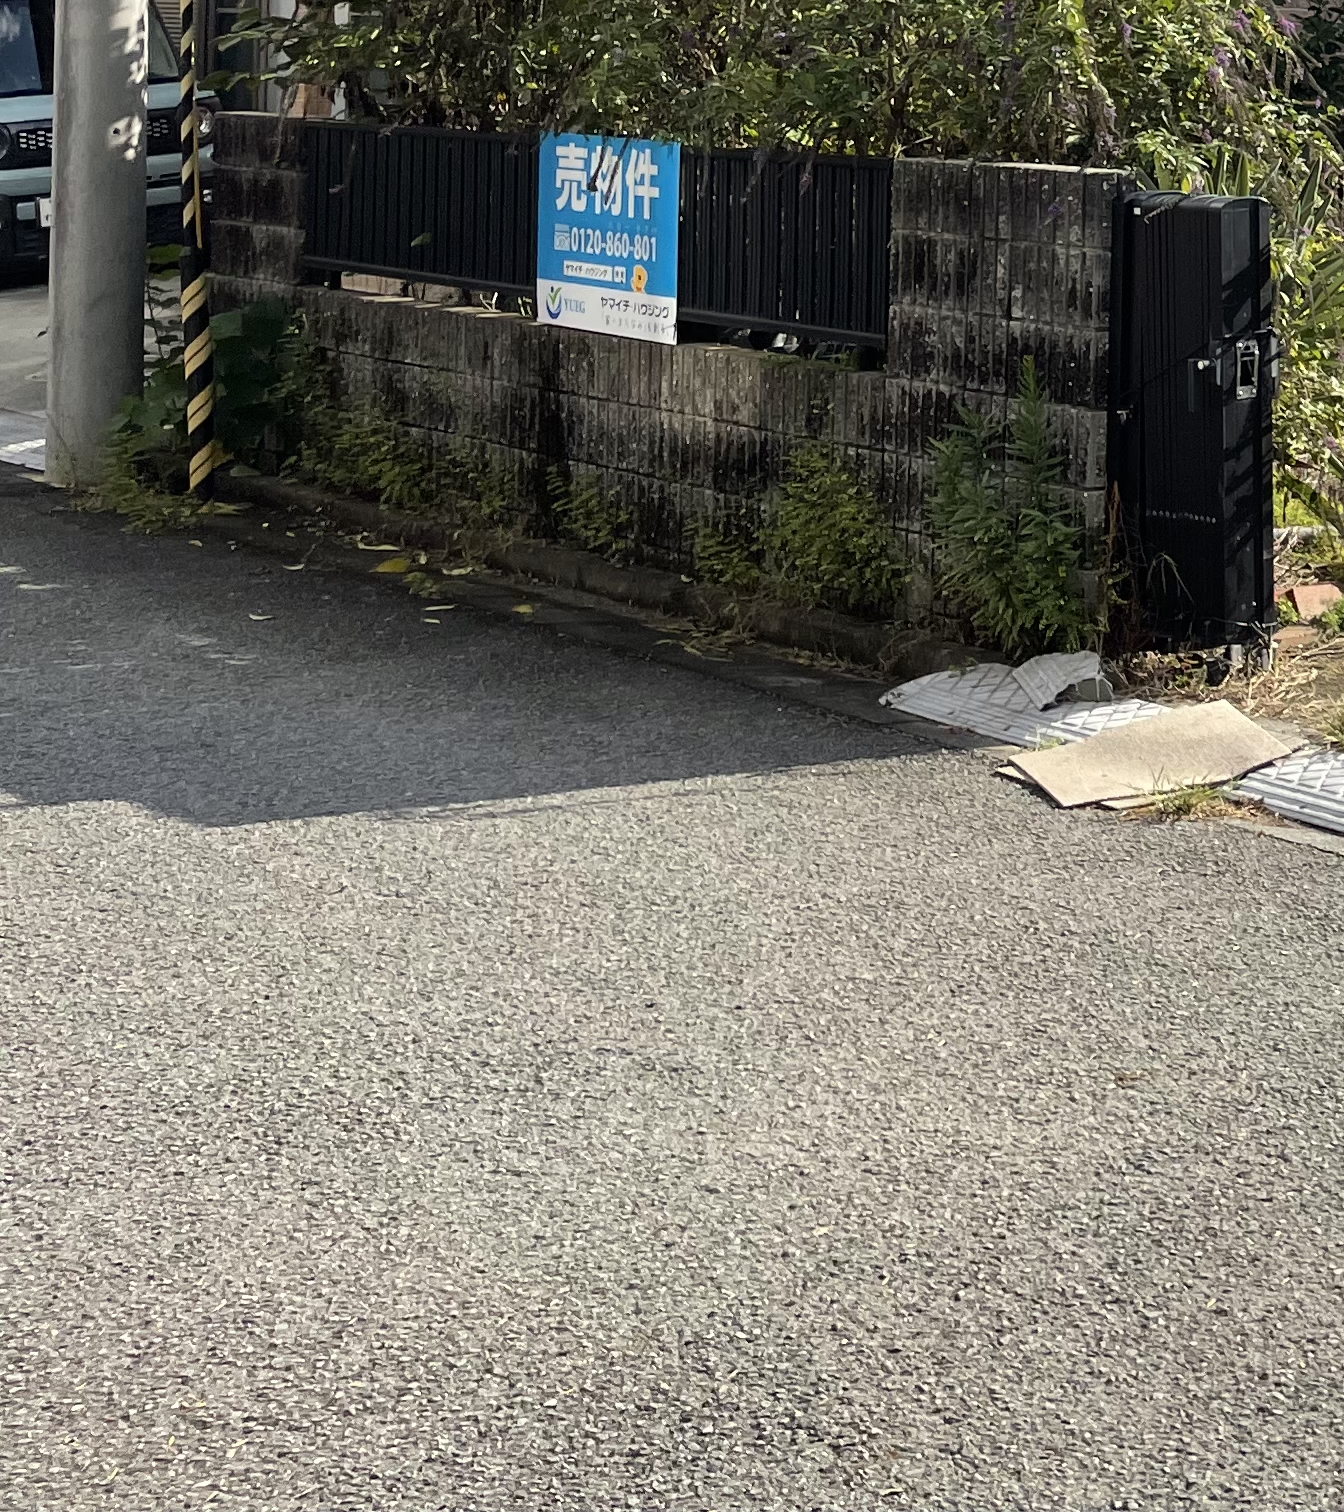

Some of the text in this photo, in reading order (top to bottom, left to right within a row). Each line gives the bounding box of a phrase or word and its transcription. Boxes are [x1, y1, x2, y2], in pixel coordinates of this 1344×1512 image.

[555, 142, 660, 220] 売物件
[571, 226, 657, 263] 0120-860-801
